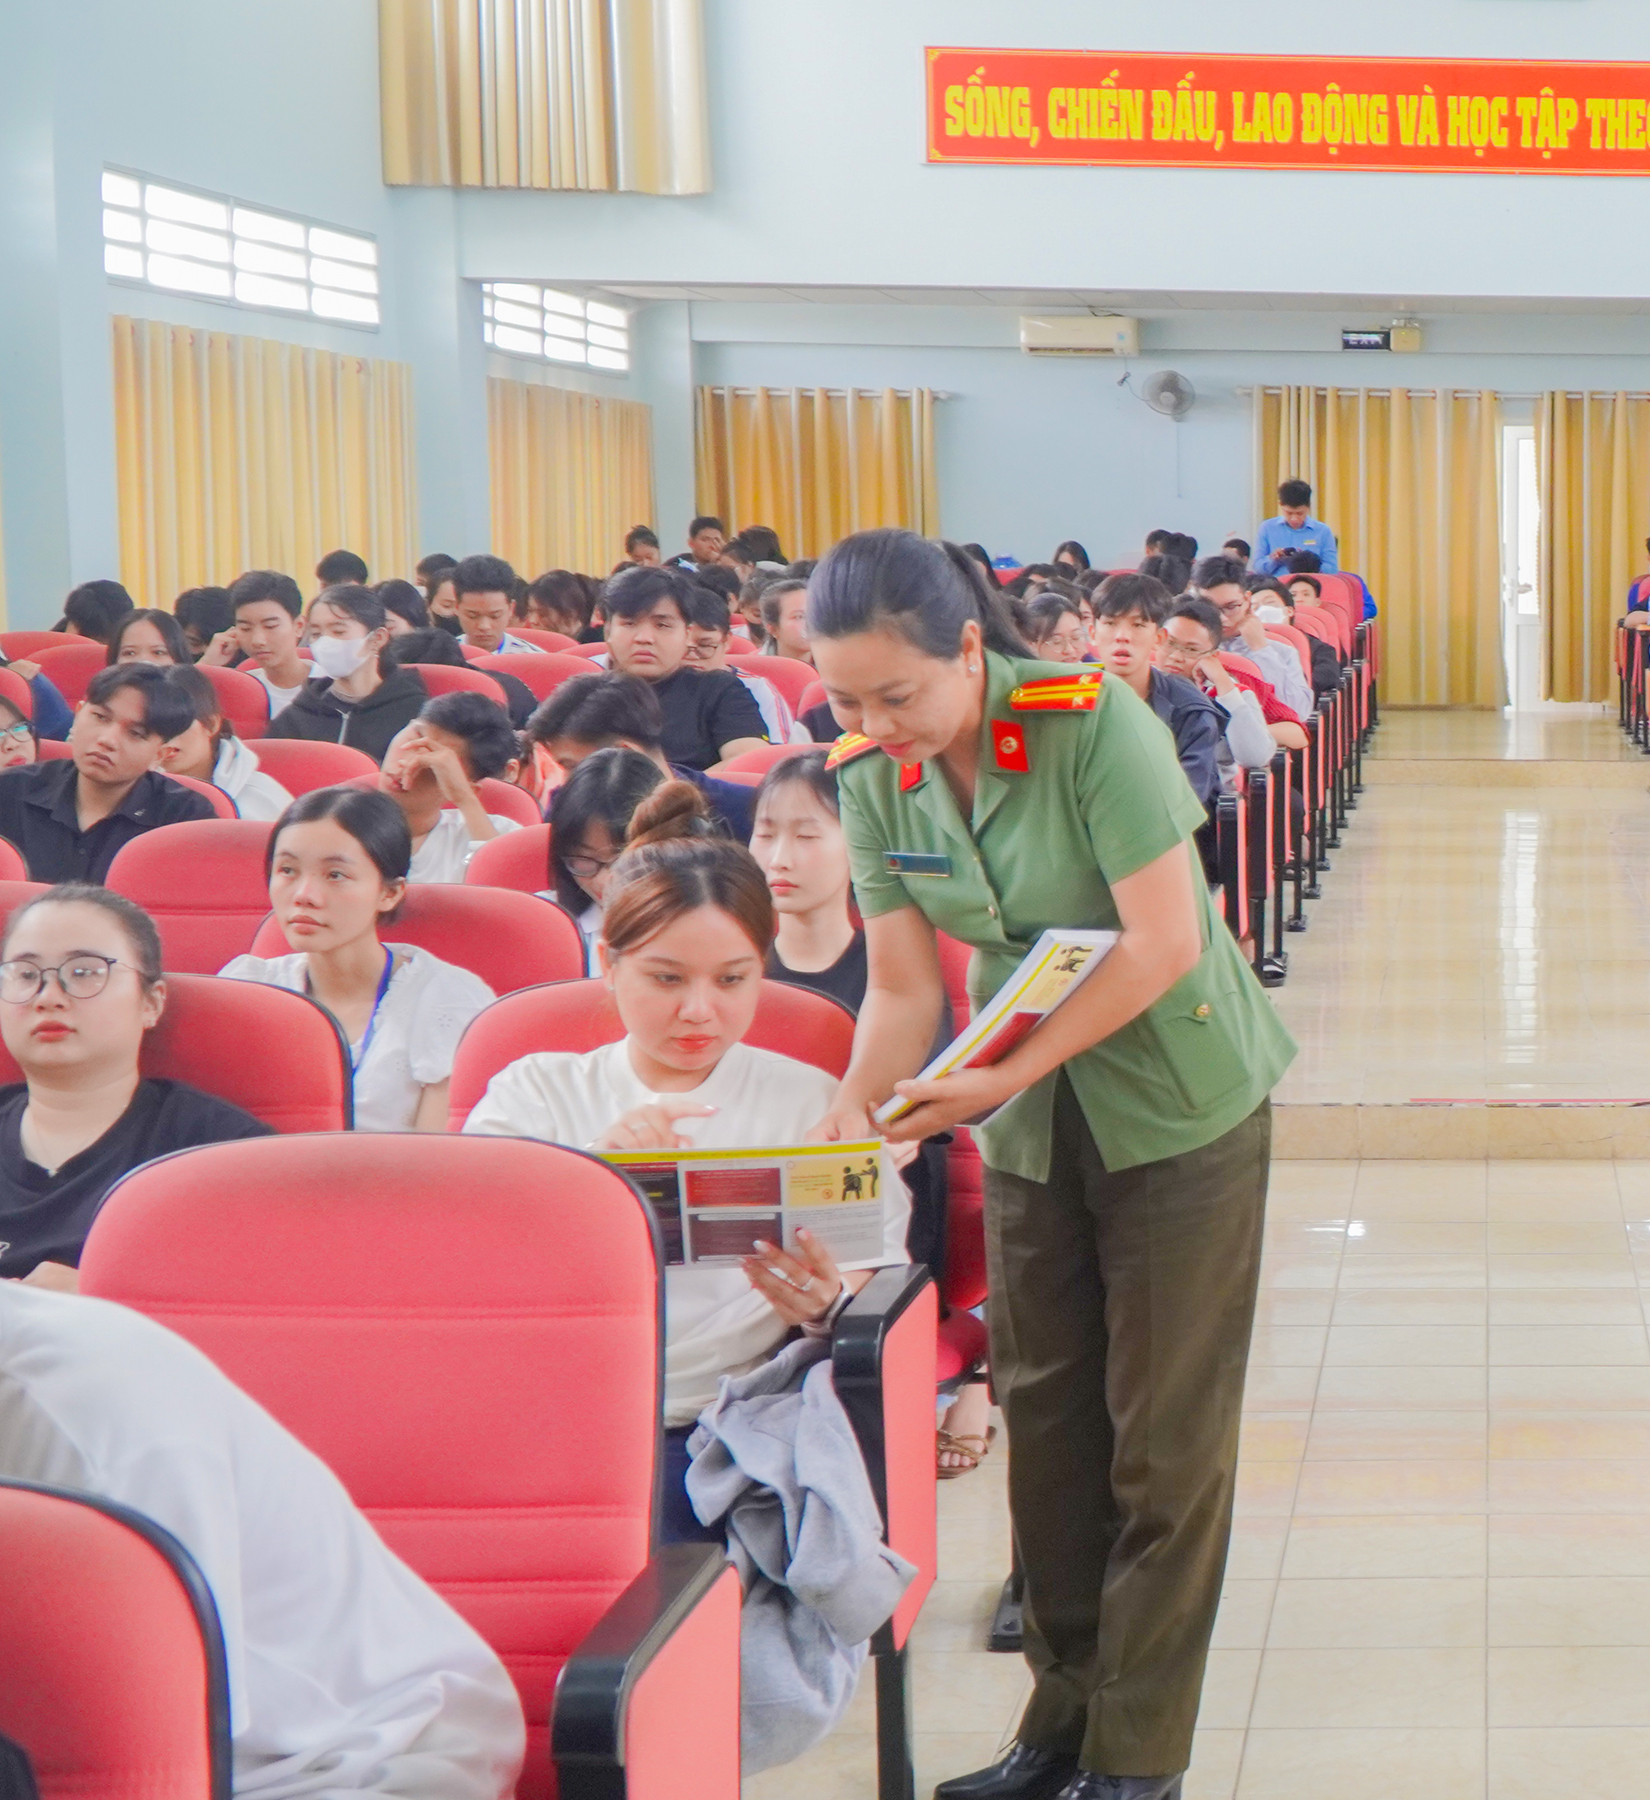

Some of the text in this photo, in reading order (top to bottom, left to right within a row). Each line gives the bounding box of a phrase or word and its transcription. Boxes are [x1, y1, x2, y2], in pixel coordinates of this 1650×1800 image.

[945, 66, 1039, 147] SỐNG,
[1048, 69, 1144, 140] CHIẾN
[1152, 71, 1224, 151] ĐẤU,
[1232, 91, 1293, 143] LAO
[1301, 83, 1388, 154] ĐỘNG
[1397, 85, 1439, 146] VÀ
[1447, 96, 1508, 157] HỌC
[1516, 87, 1578, 158] TẬP
